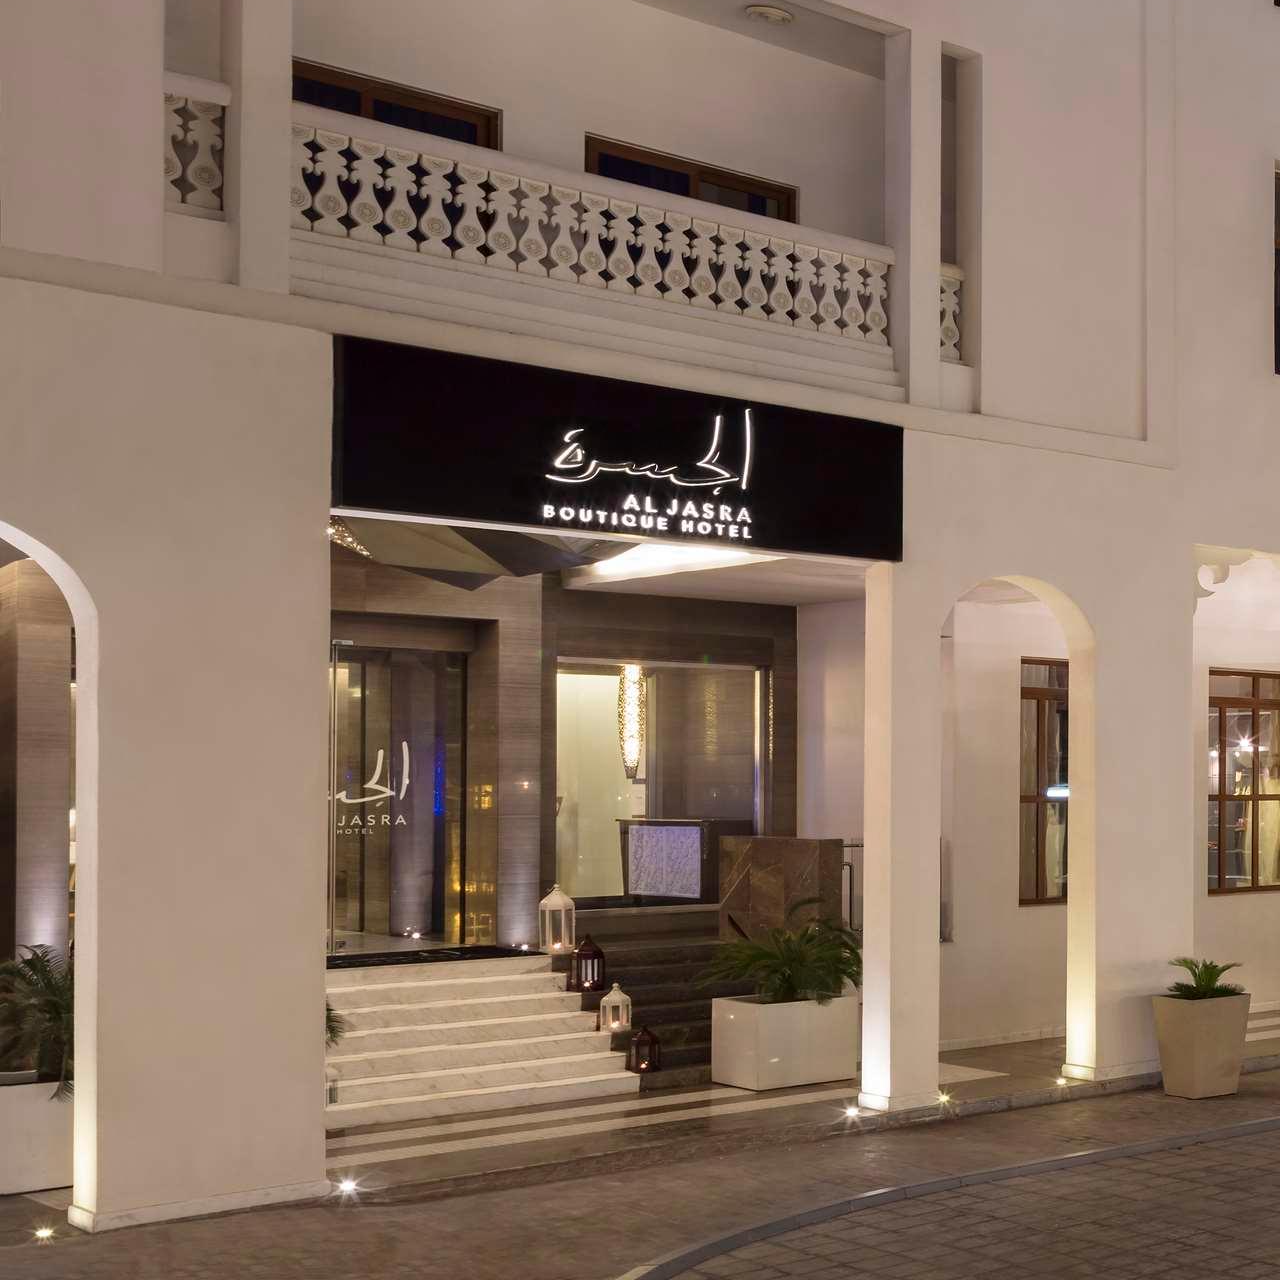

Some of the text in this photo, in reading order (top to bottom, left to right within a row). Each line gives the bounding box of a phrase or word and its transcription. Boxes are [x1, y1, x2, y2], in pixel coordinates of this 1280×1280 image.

[545, 408, 753, 495] الجسرة
[543, 504, 753, 539] BOUTIQUE HOTEL
[623, 494, 752, 523] AL JASRA
[337, 814, 407, 826] JASRA
